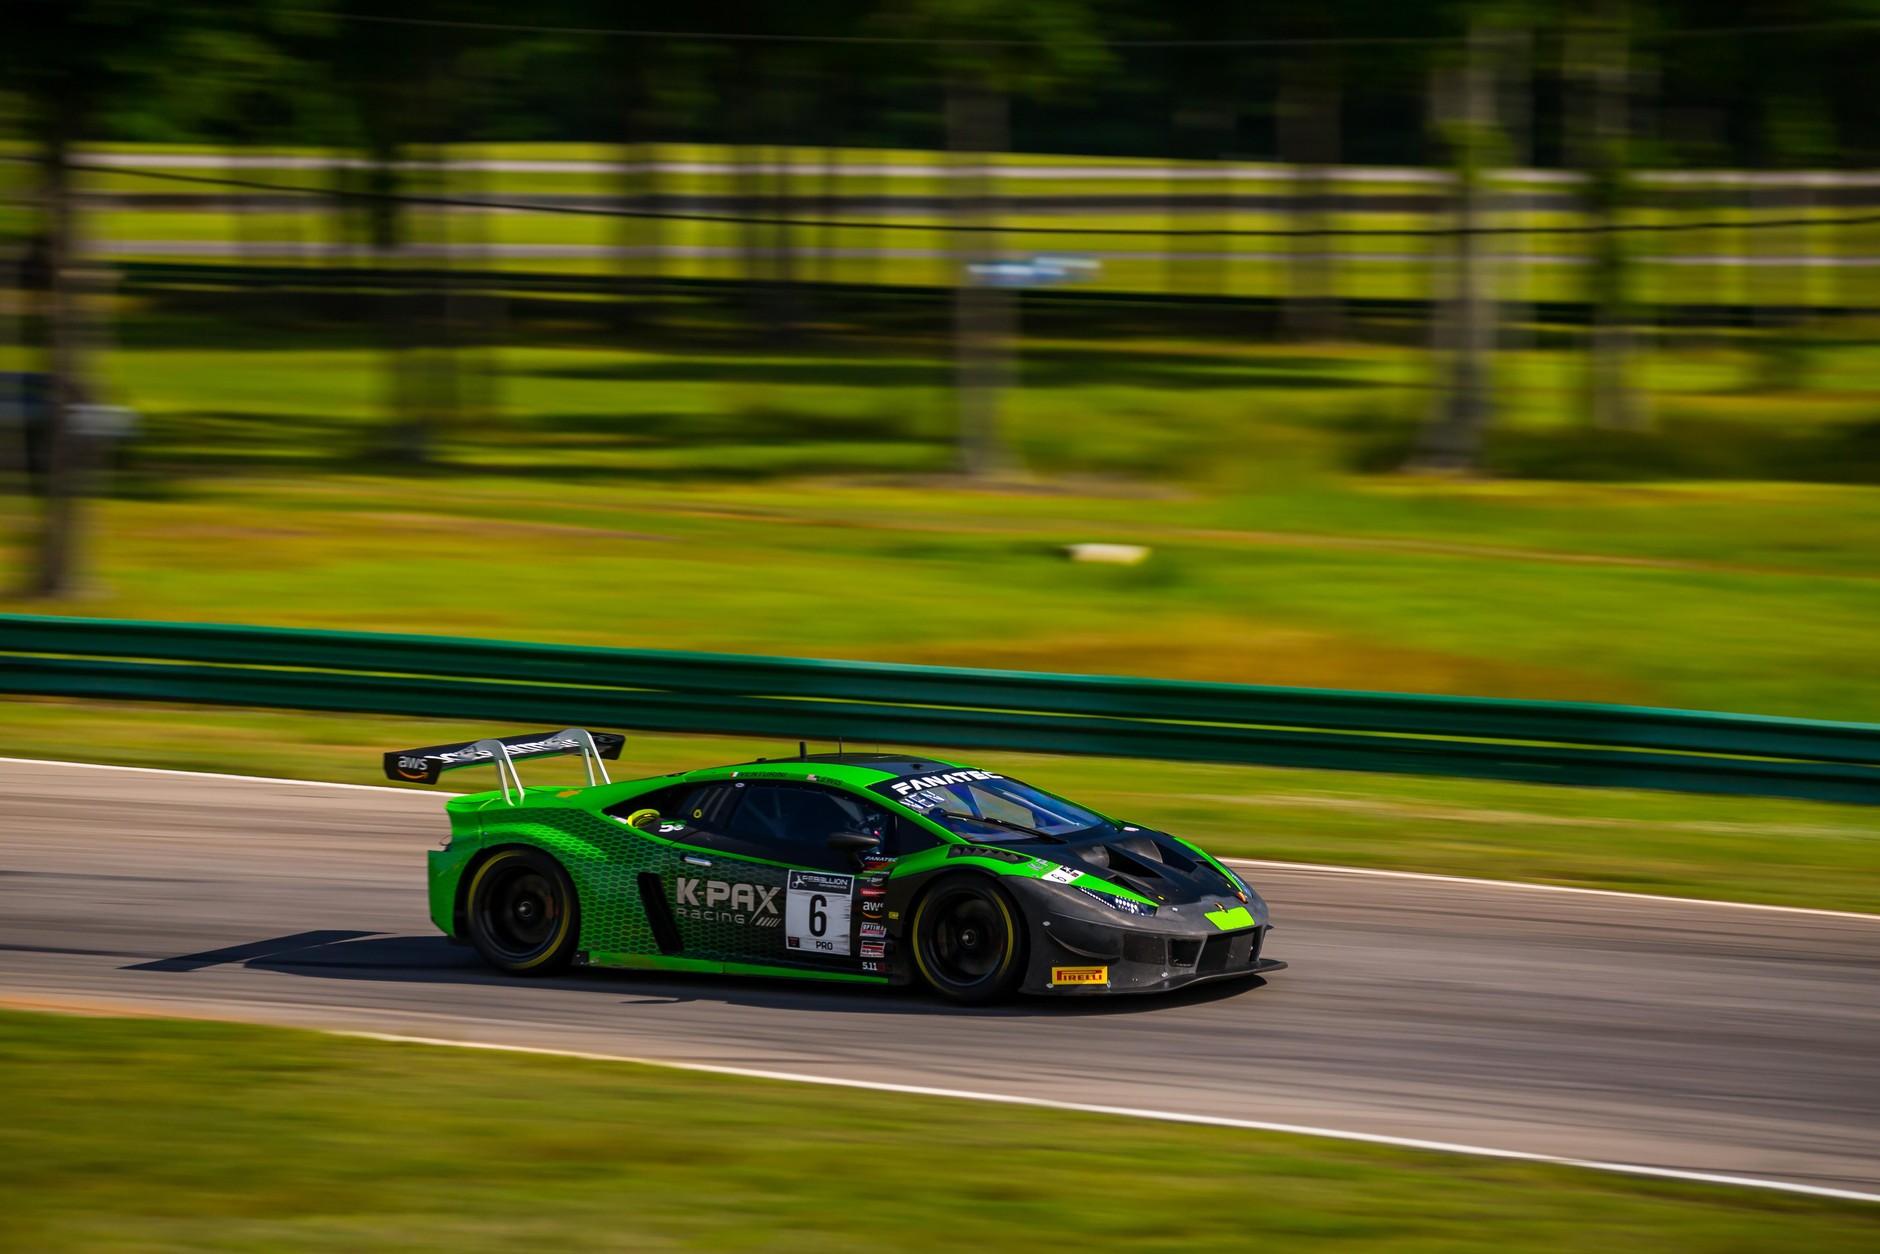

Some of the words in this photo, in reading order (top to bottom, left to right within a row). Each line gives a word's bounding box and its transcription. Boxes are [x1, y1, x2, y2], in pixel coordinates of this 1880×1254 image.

[398, 756, 428, 771] aws
[891, 770, 1004, 796] FANATEC
[677, 877, 781, 924] K-PAX
[808, 893, 828, 938] 6
[815, 940, 834, 951] PRO
[862, 961, 878, 971] 5.11
[1056, 969, 1103, 981] PIRELLI
